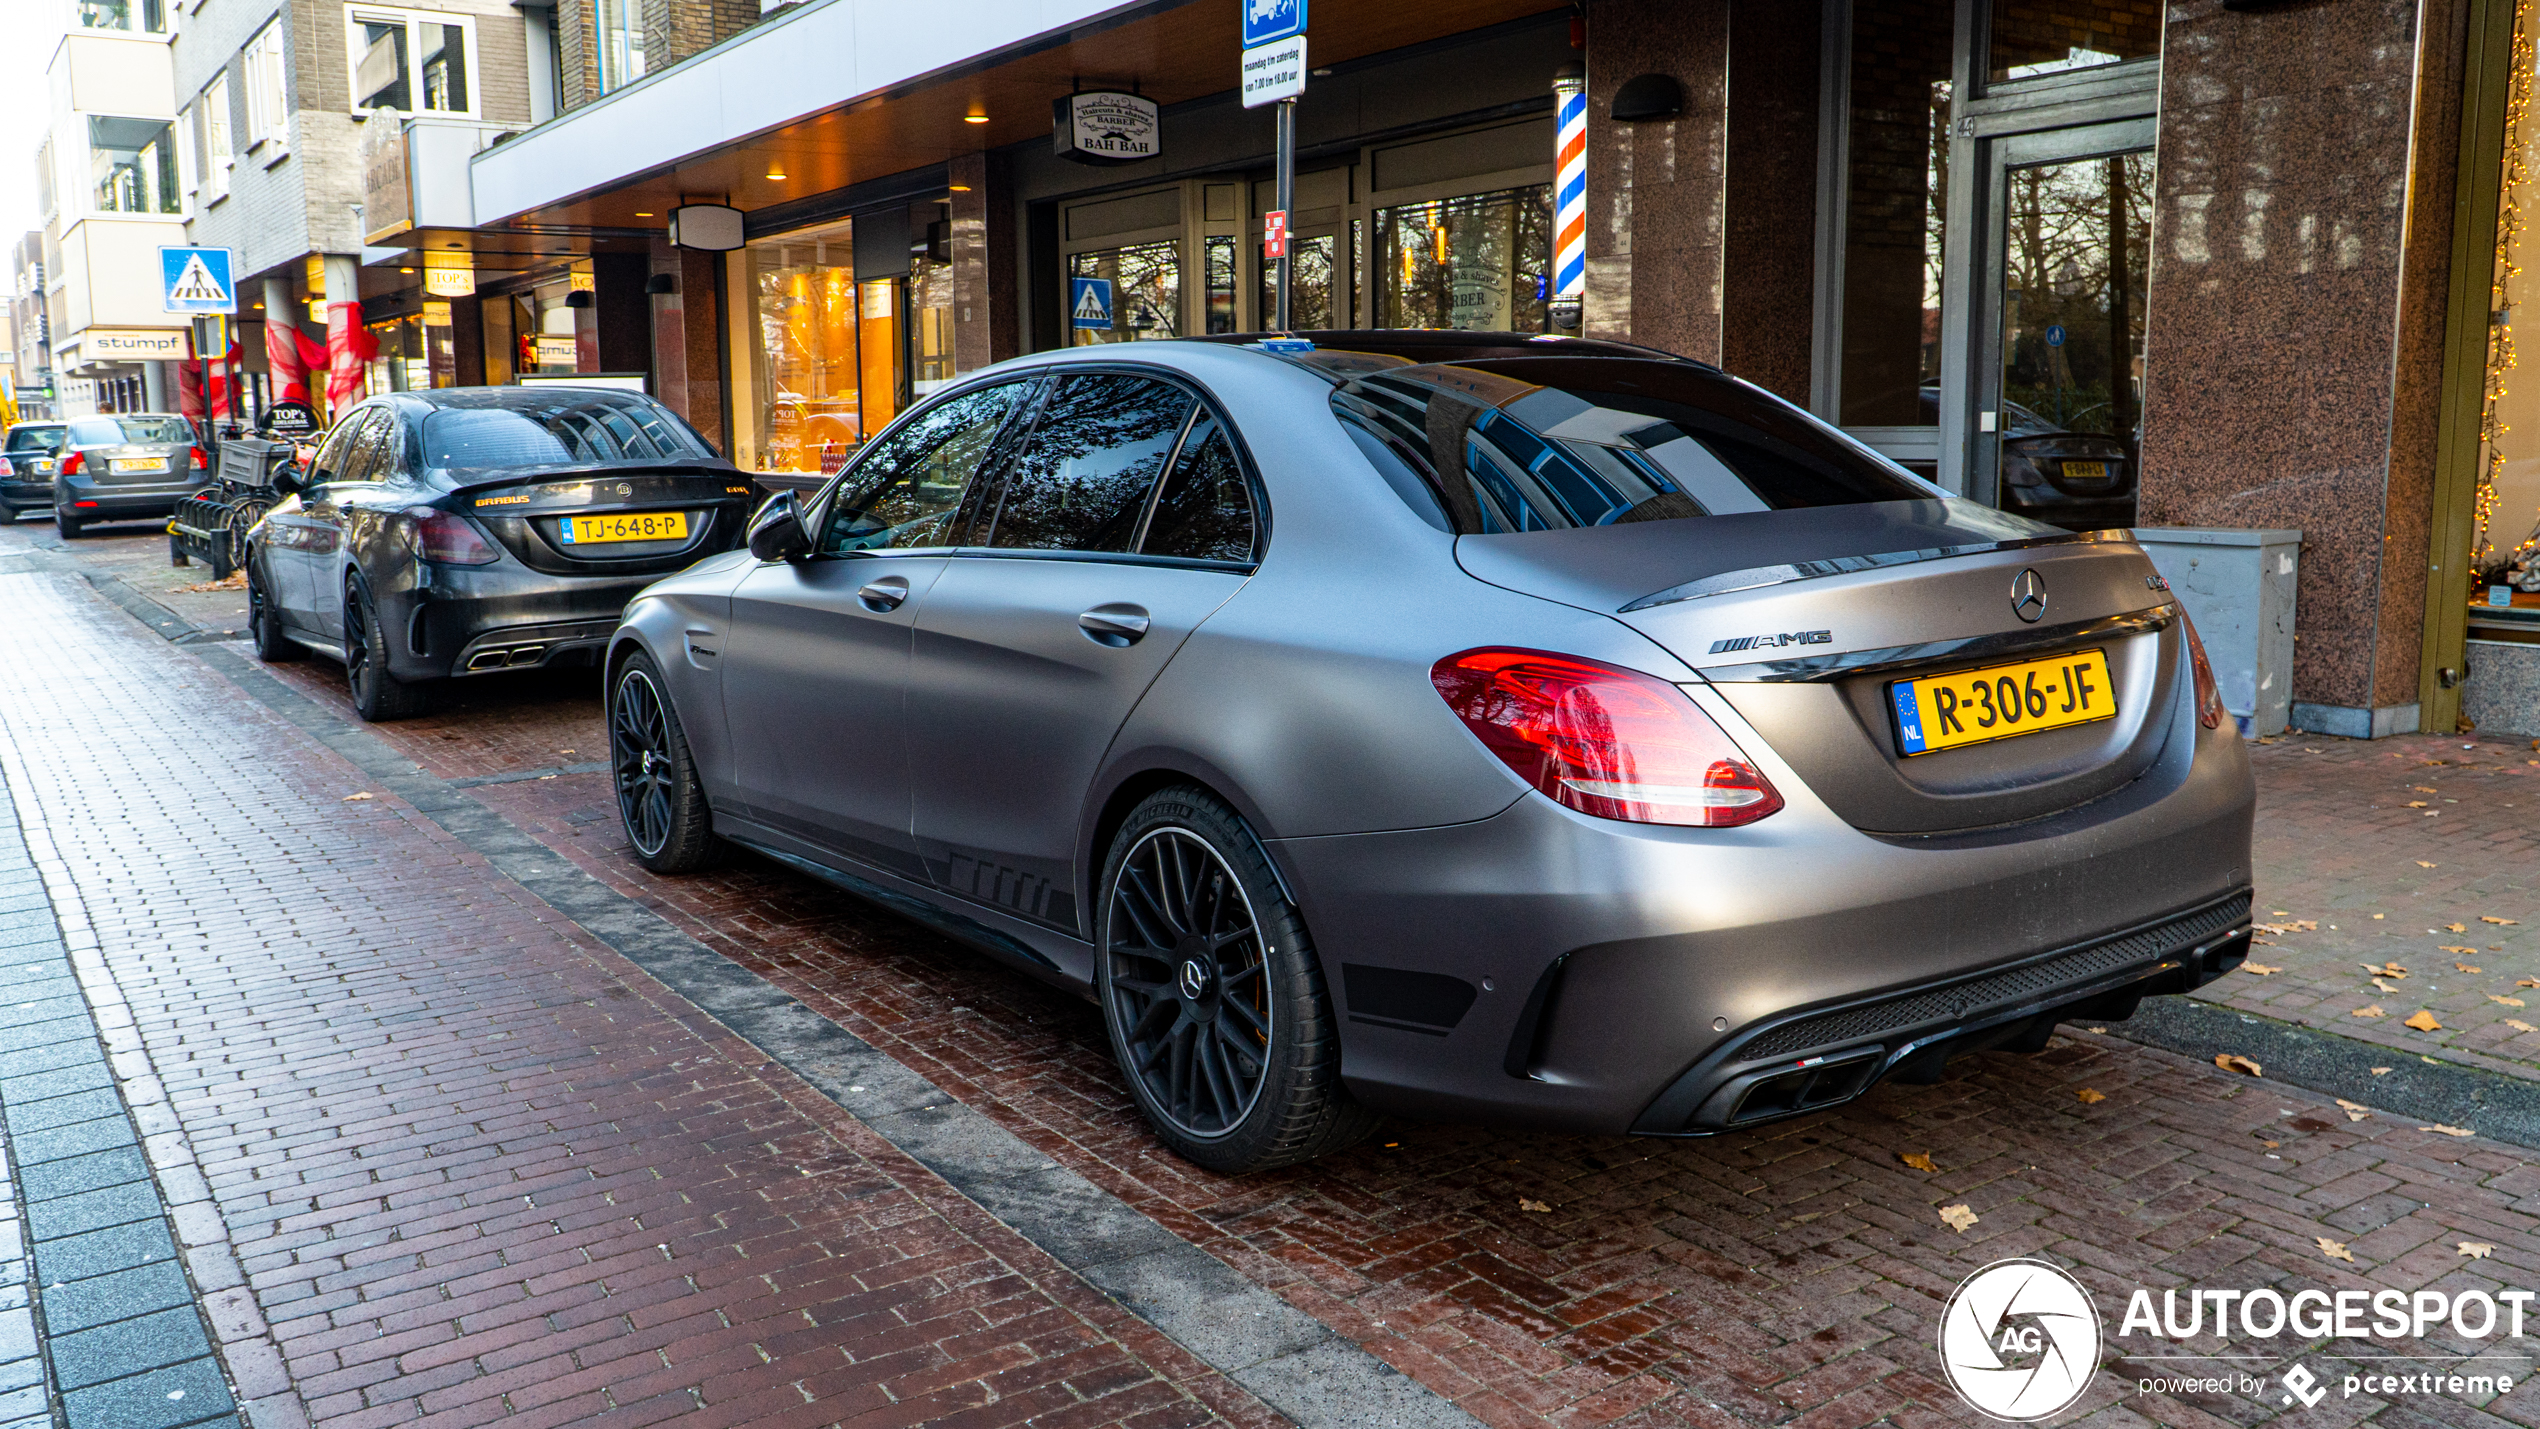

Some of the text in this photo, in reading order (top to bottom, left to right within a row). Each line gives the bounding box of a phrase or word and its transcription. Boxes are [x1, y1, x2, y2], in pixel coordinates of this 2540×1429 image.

[1245, 58, 1266, 72] maandag
[1276, 48, 1299, 63] zaterdag
[1245, 83, 1254, 92] van
[1254, 77, 1265, 90] 7.00
[1274, 71, 1287, 85] 18.00
[1289, 71, 1297, 81] uur
[1081, 107, 1114, 116] Haircuts
[1124, 109, 1149, 122] shaves
[1097, 116, 1136, 126] BARBER
[1084, 138, 1149, 153] BAH BAH
[434, 272, 468, 284] TOP's
[1461, 270, 1468, 280] &
[1471, 271, 1500, 287] shaves
[1453, 292, 1485, 308] RBER
[98, 337, 179, 350] stumpf
[272, 409, 307, 419] TOP's
[475, 495, 530, 507] BRABUS
[581, 516, 676, 538] TJ-648-P
[563, 532, 574, 540] NL
[1752, 629, 1833, 648] AMG
[1934, 663, 2096, 737] R-306-JF
[1904, 725, 1921, 741] NL
[1137, 803, 1191, 822] MICHELIN
